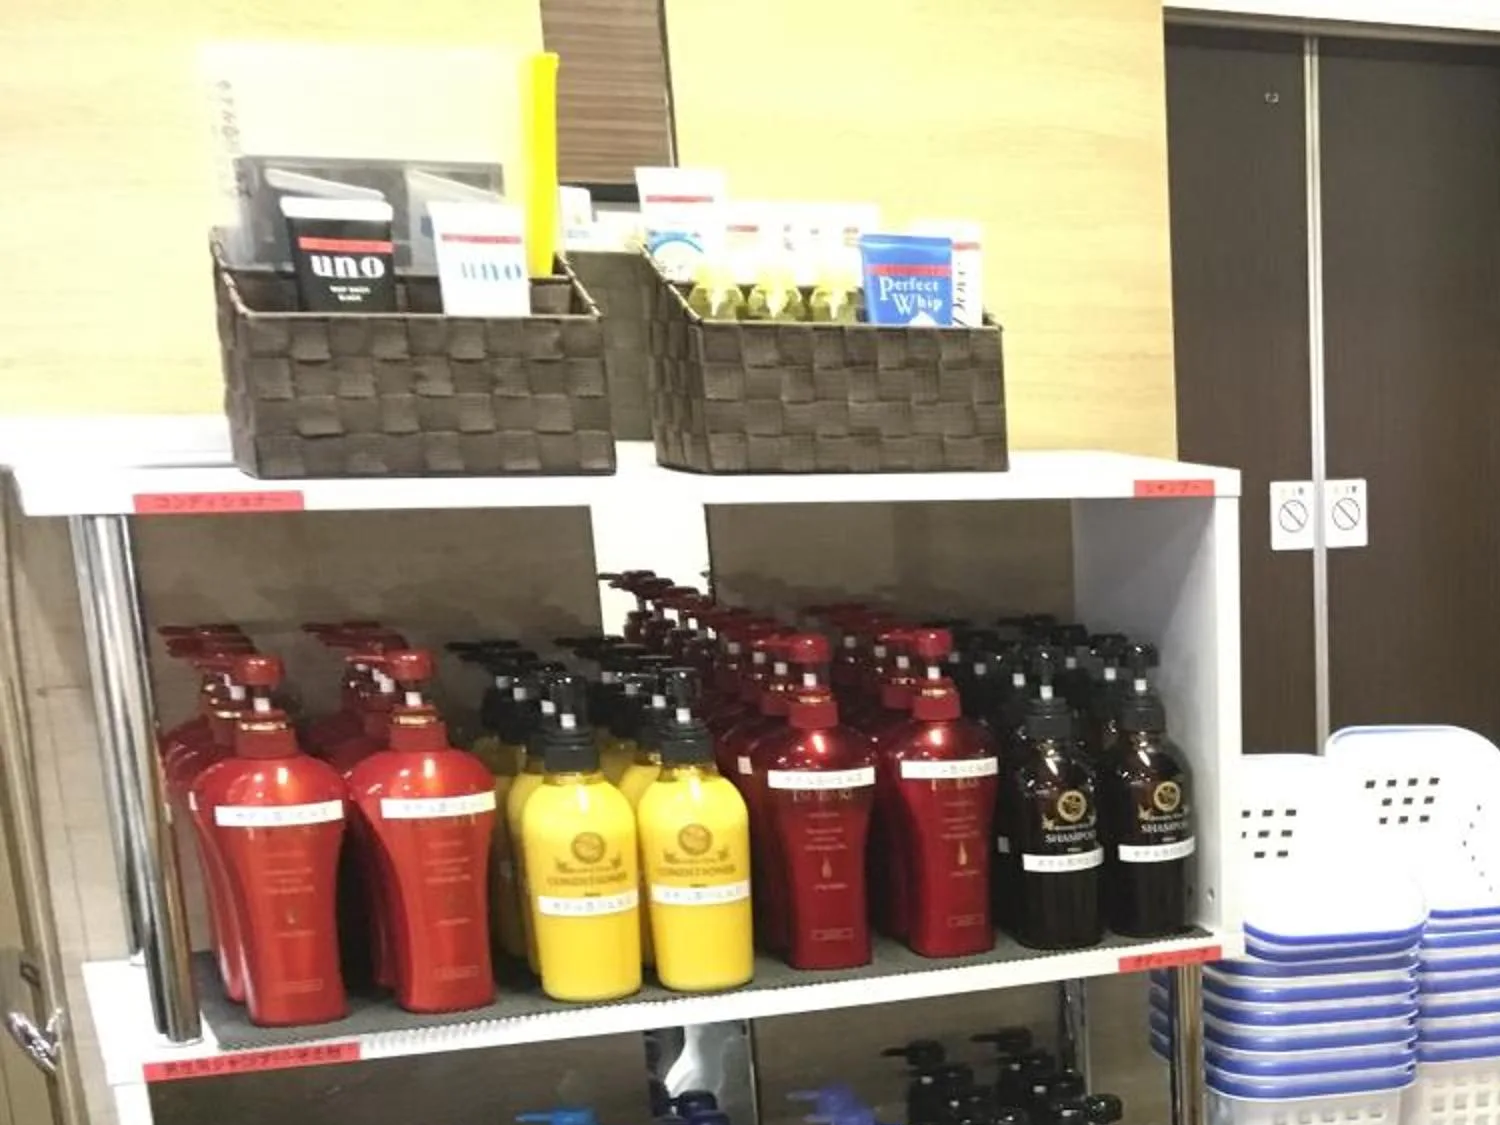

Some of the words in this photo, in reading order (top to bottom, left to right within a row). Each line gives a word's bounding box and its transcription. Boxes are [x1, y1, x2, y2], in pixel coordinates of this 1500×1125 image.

[310, 255, 386, 279] uno
[879, 276, 939, 301] Perfect
[891, 291, 943, 316] Whip
